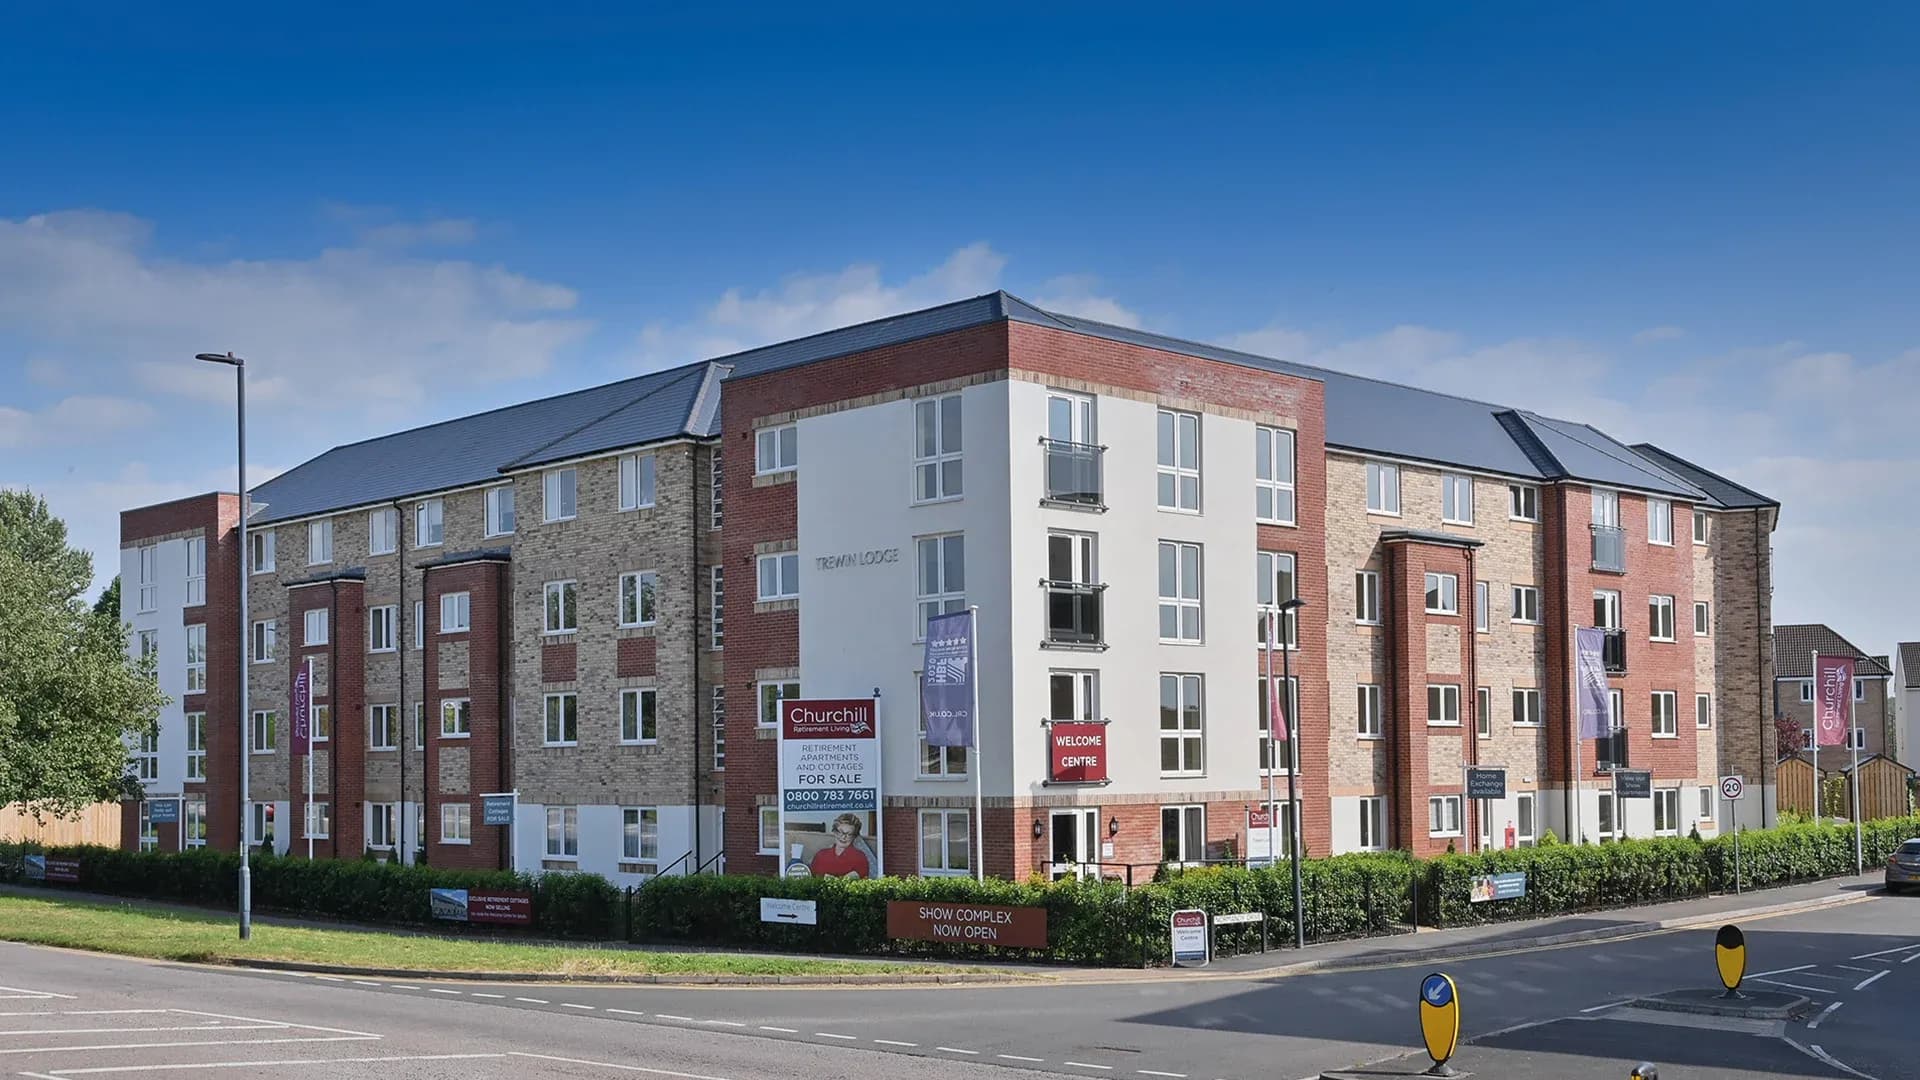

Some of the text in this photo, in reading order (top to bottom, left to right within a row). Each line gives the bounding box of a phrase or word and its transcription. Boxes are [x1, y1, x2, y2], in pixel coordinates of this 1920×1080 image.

[816, 548, 899, 571] TREWIN LODGE
[1823, 667, 1836, 730] Churchill
[790, 707, 867, 723] Churchill
[1056, 735, 1102, 746] WELCOME
[802, 744, 856, 752] RETIREMENT
[1061, 756, 1097, 767] CENTRE
[796, 763, 864, 771] AND COTTAGES
[799, 774, 862, 784] FOR SALE
[1470, 780, 1504, 788] Exchange
[1725, 783, 1739, 792] 20
[786, 790, 874, 800] 0800 783 7661
[786, 801, 874, 810] churchillretirement.co.uk
[919, 906, 1013, 924] SHOW COMPLEX
[933, 924, 997, 940] NOW OPEN
